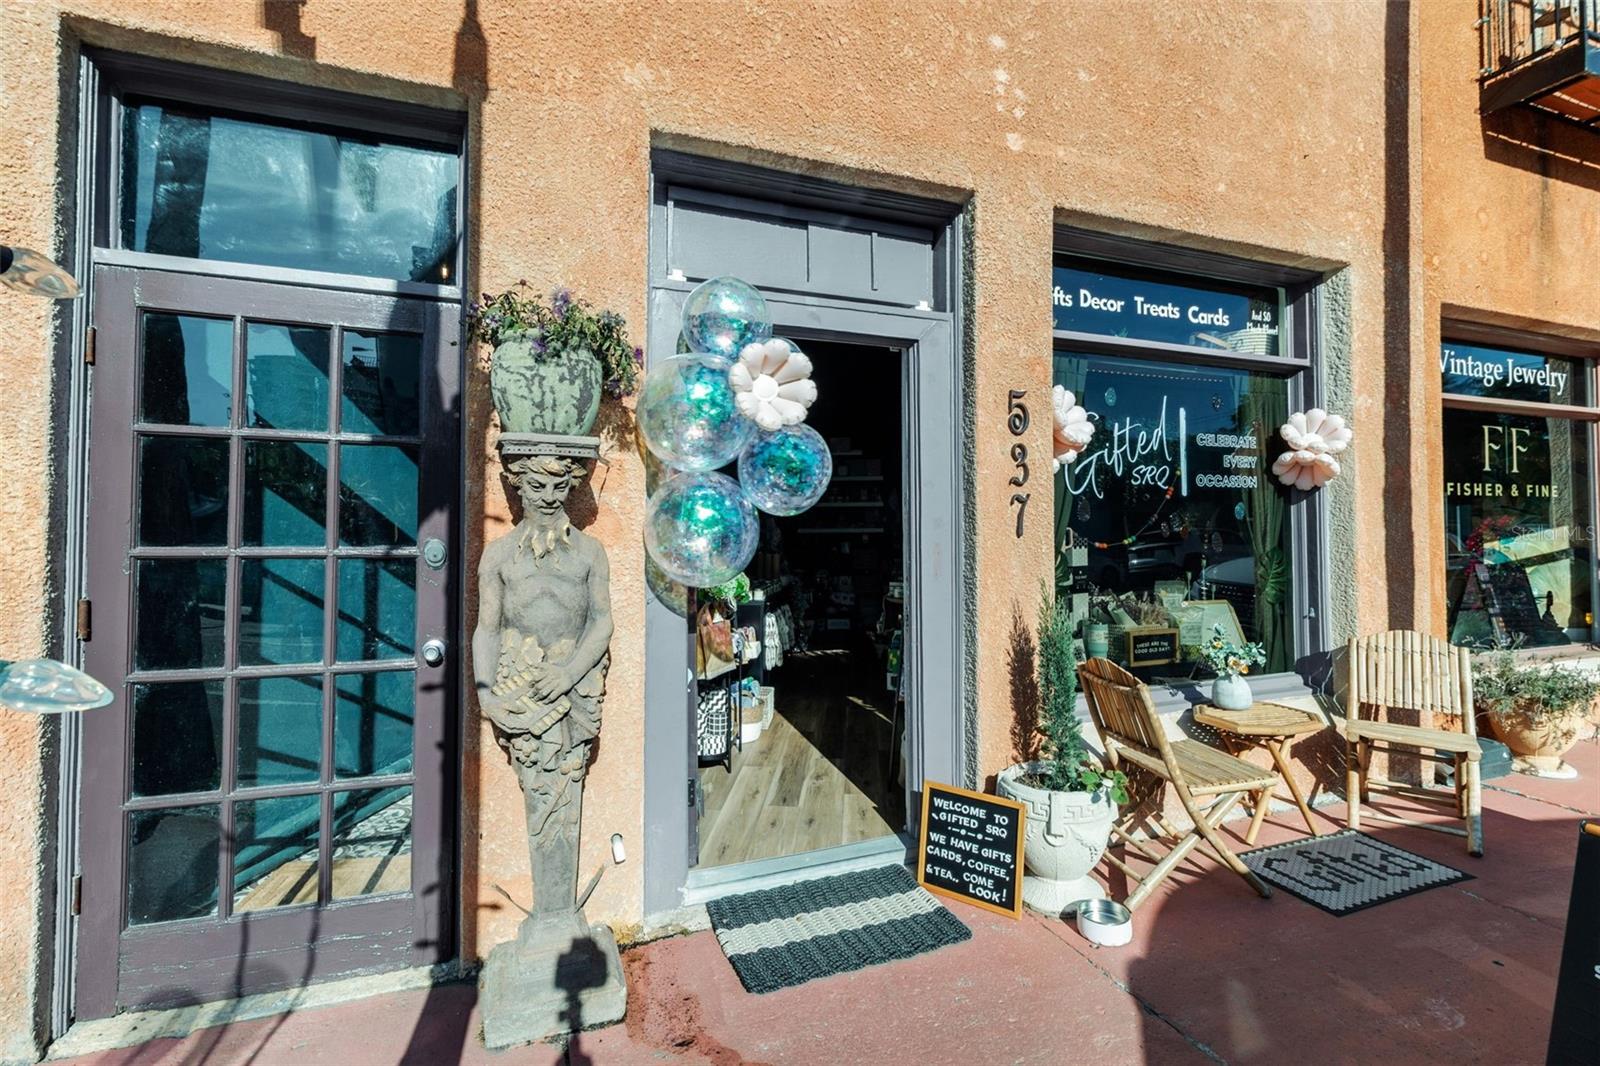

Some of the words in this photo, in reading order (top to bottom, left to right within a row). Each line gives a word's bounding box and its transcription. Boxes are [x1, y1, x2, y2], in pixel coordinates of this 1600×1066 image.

[1080, 288, 1125, 313] Decor
[1134, 296, 1180, 319] Treats
[1188, 306, 1230, 327] Cards
[1440, 349, 1503, 387] Vintage
[1506, 358, 1567, 396] Jewelry
[1064, 395, 1173, 499] Gifted
[1196, 433, 1257, 449] CELEBRATE
[1007, 389, 1030, 538] 537
[1223, 454, 1257, 468] EVERY
[1131, 465, 1170, 489] SRQ
[1195, 474, 1258, 489] OCCASION
[1447, 482, 1503, 497] FISHER
[1511, 484, 1519, 497] &
[1526, 484, 1559, 498] FINE
[933, 797, 987, 819] WELCOME
[993, 814, 1009, 826] TO
[929, 831, 947, 845] WE
[950, 837, 979, 854] HAVE
[985, 824, 1008, 839] SRQ
[926, 845, 966, 866] CARDS,
[967, 859, 1010, 881] COFFEE,
[963, 872, 994, 889] COME
